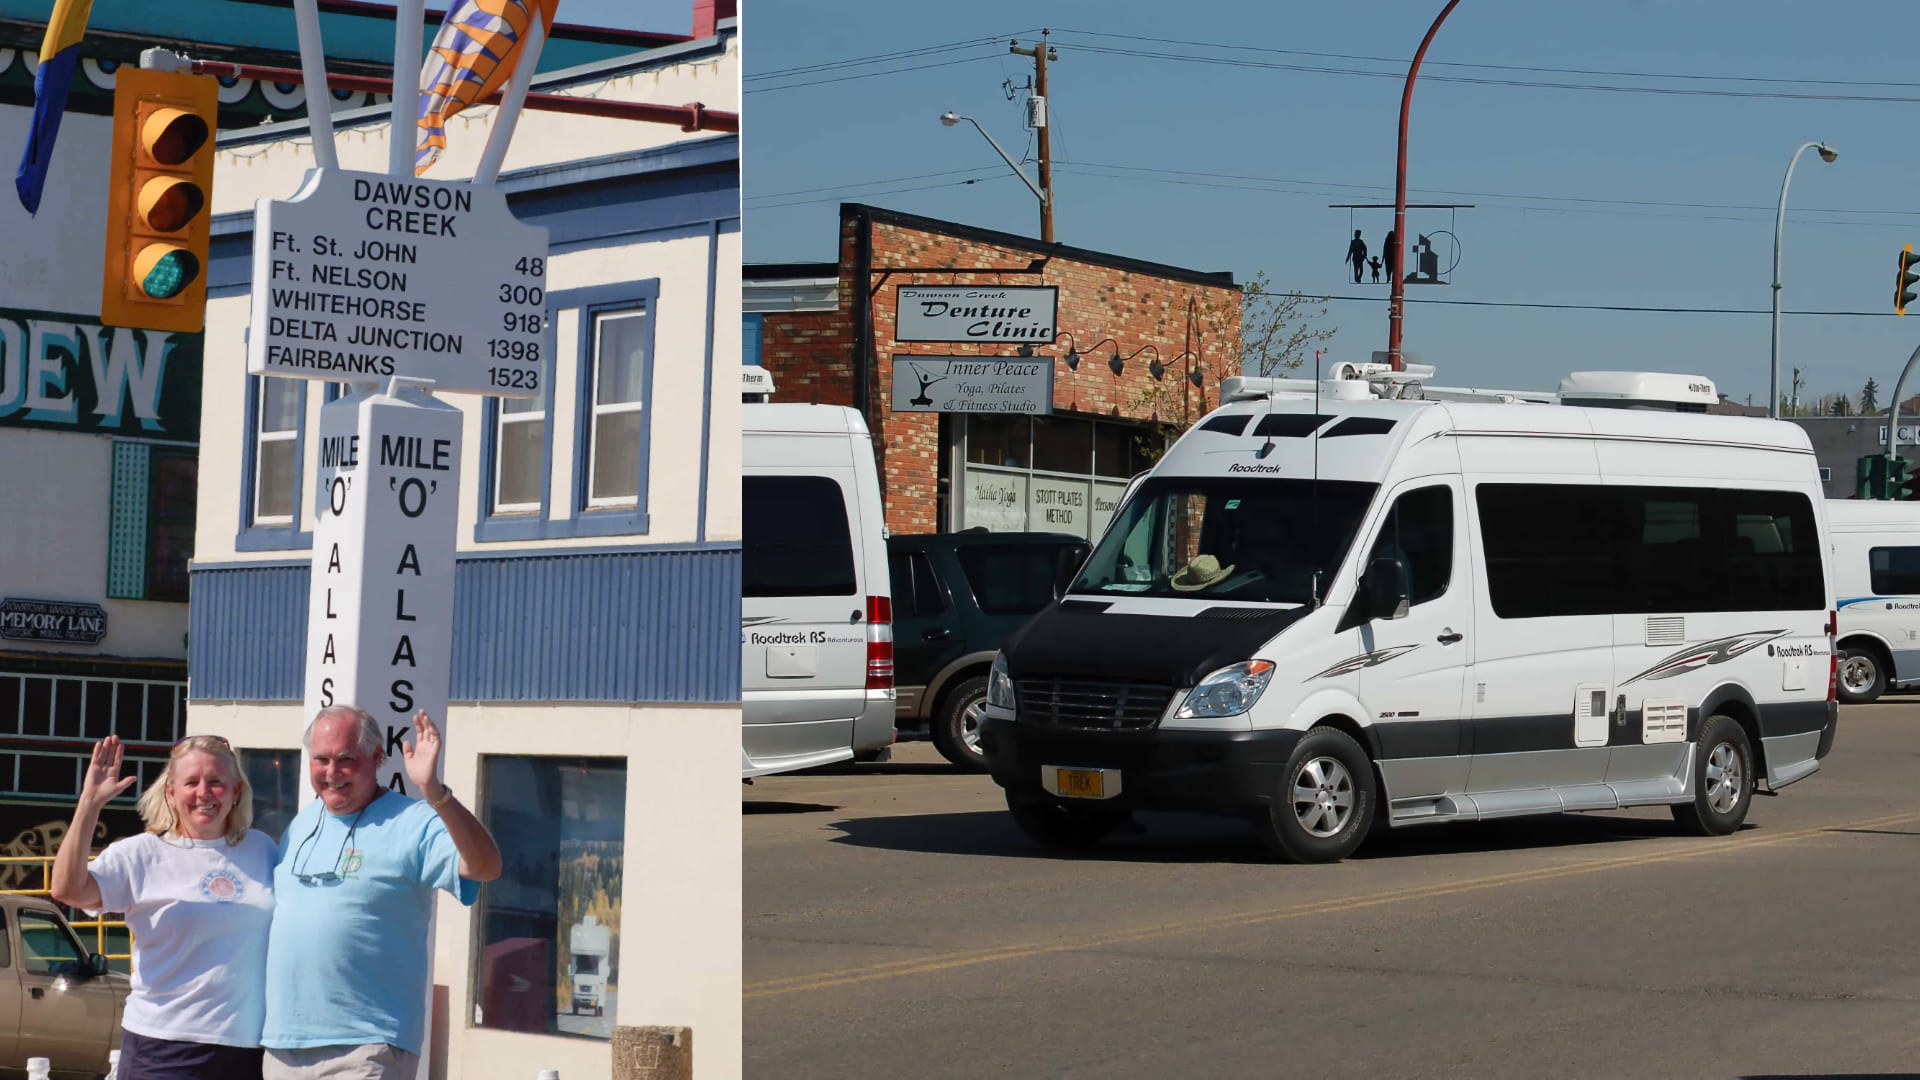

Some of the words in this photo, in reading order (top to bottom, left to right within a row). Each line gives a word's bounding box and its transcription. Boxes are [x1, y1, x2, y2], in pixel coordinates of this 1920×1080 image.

[354, 179, 472, 212] DAWSON
[366, 207, 457, 238] CREEK
[272, 231, 301, 253] Ft.
[312, 235, 343, 257] St.
[354, 240, 417, 264] JOHN
[515, 257, 543, 277] 48
[272, 260, 301, 282] Ft.
[312, 264, 407, 292] NELSON
[499, 284, 543, 306] 300
[902, 291, 960, 299] Dawson
[965, 291, 1007, 299] Creek
[271, 289, 426, 322] WHITEHORSE
[503, 312, 541, 334] 918
[920, 301, 1031, 318] Denture
[966, 321, 1051, 338] Clinic
[269, 317, 337, 342] DELTA
[347, 326, 463, 354] JUNCTION
[487, 339, 540, 362] 1398
[268, 346, 396, 376] FAIRBANKS
[487, 367, 538, 390] 1523
[944, 360, 991, 375] Inner
[993, 360, 1039, 376] Peace
[956, 383, 985, 397] Yoga,
[988, 382, 1026, 394] Pilates
[943, 400, 955, 411] &
[959, 400, 998, 411] Fitness
[1000, 400, 1037, 412] Studio
[322, 435, 360, 468] MILE
[380, 434, 451, 471] MILE
[1228, 463, 1281, 474] Roadtrek
[1036, 489, 1056, 504] STOTT
[1058, 490, 1083, 506] PILATES
[1046, 509, 1073, 524] METHOD
[0, 612, 65, 630] MEMORY
[68, 615, 104, 632] LANE
[751, 631, 807, 645] Roadtrek
[810, 631, 826, 644] RS
[1068, 773, 1091, 791] TREK
